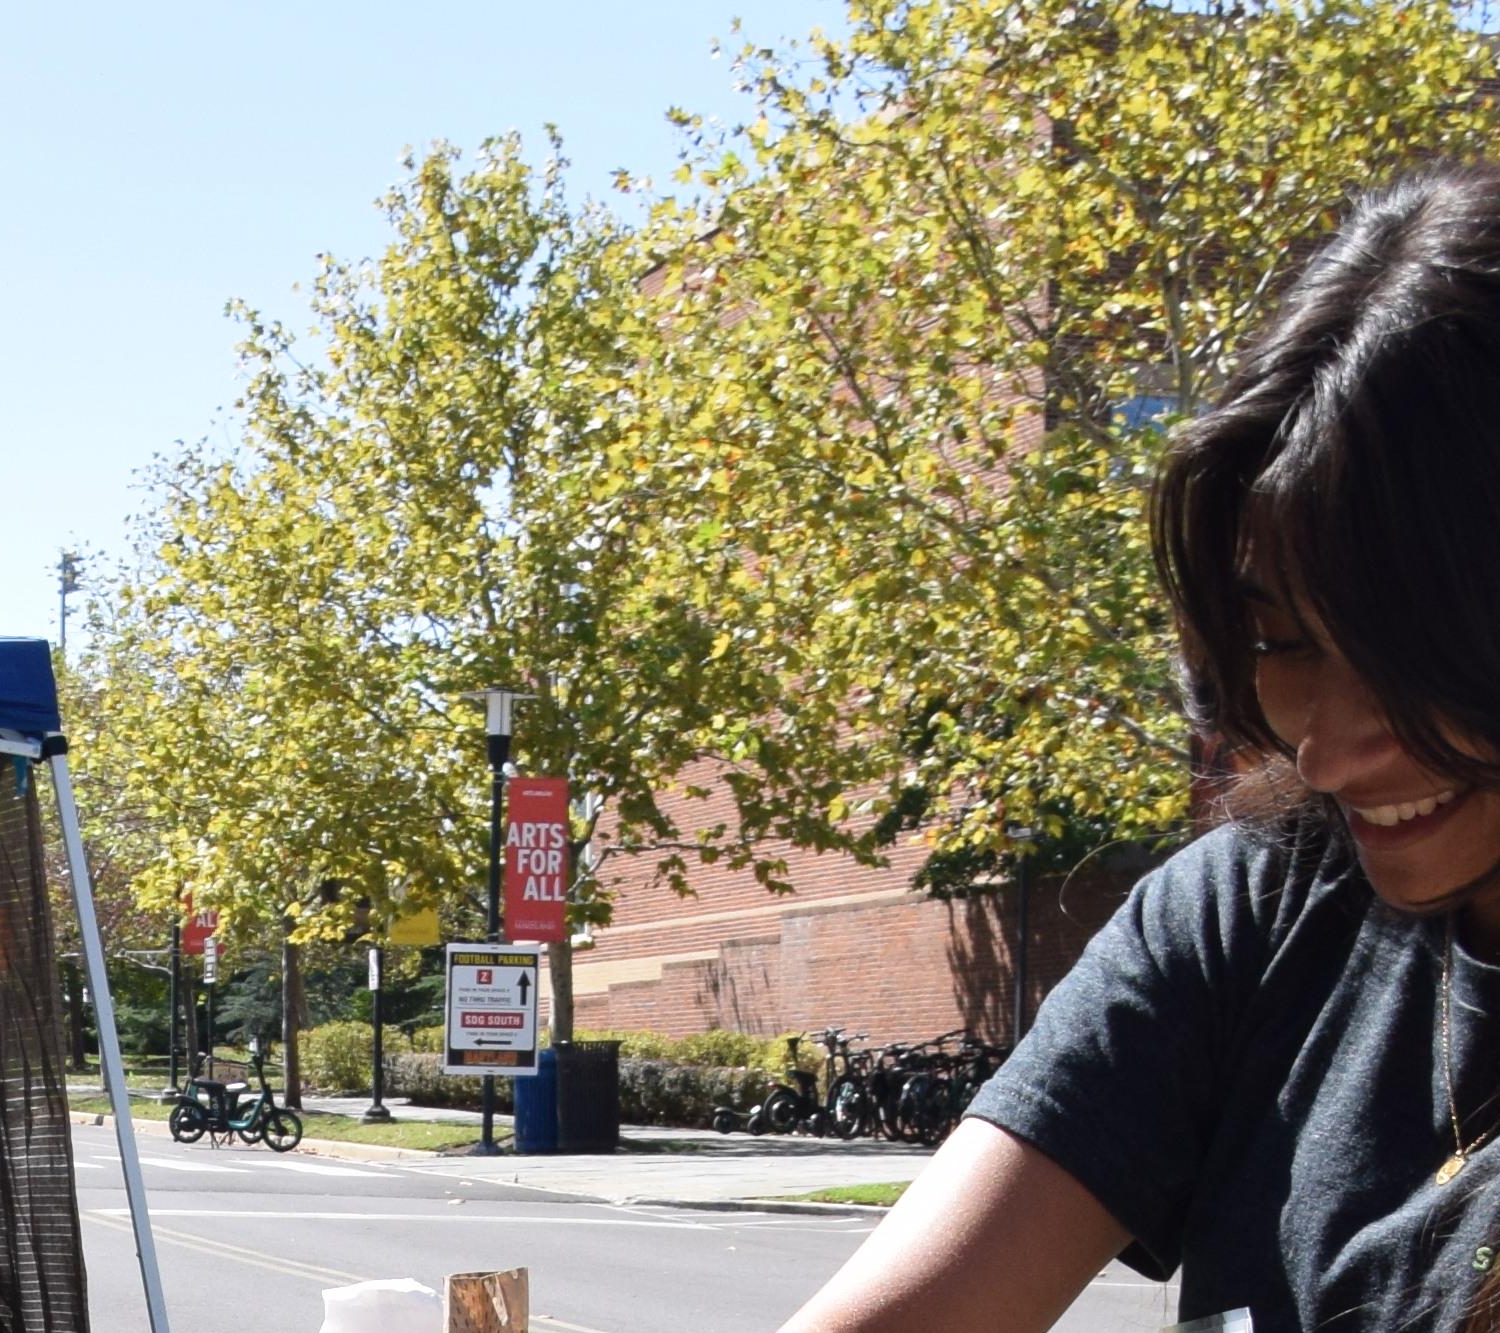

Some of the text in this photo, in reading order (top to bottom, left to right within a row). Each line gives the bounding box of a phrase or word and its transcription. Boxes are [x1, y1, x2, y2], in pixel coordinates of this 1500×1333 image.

[506, 822, 564, 848] ARTS
[517, 849, 562, 875] FOR
[523, 876, 566, 901] ALL
[454, 954, 534, 965] FOOTBALL PARKING
[479, 971, 488, 982] Z
[488, 1015, 520, 1025] SOUTH
